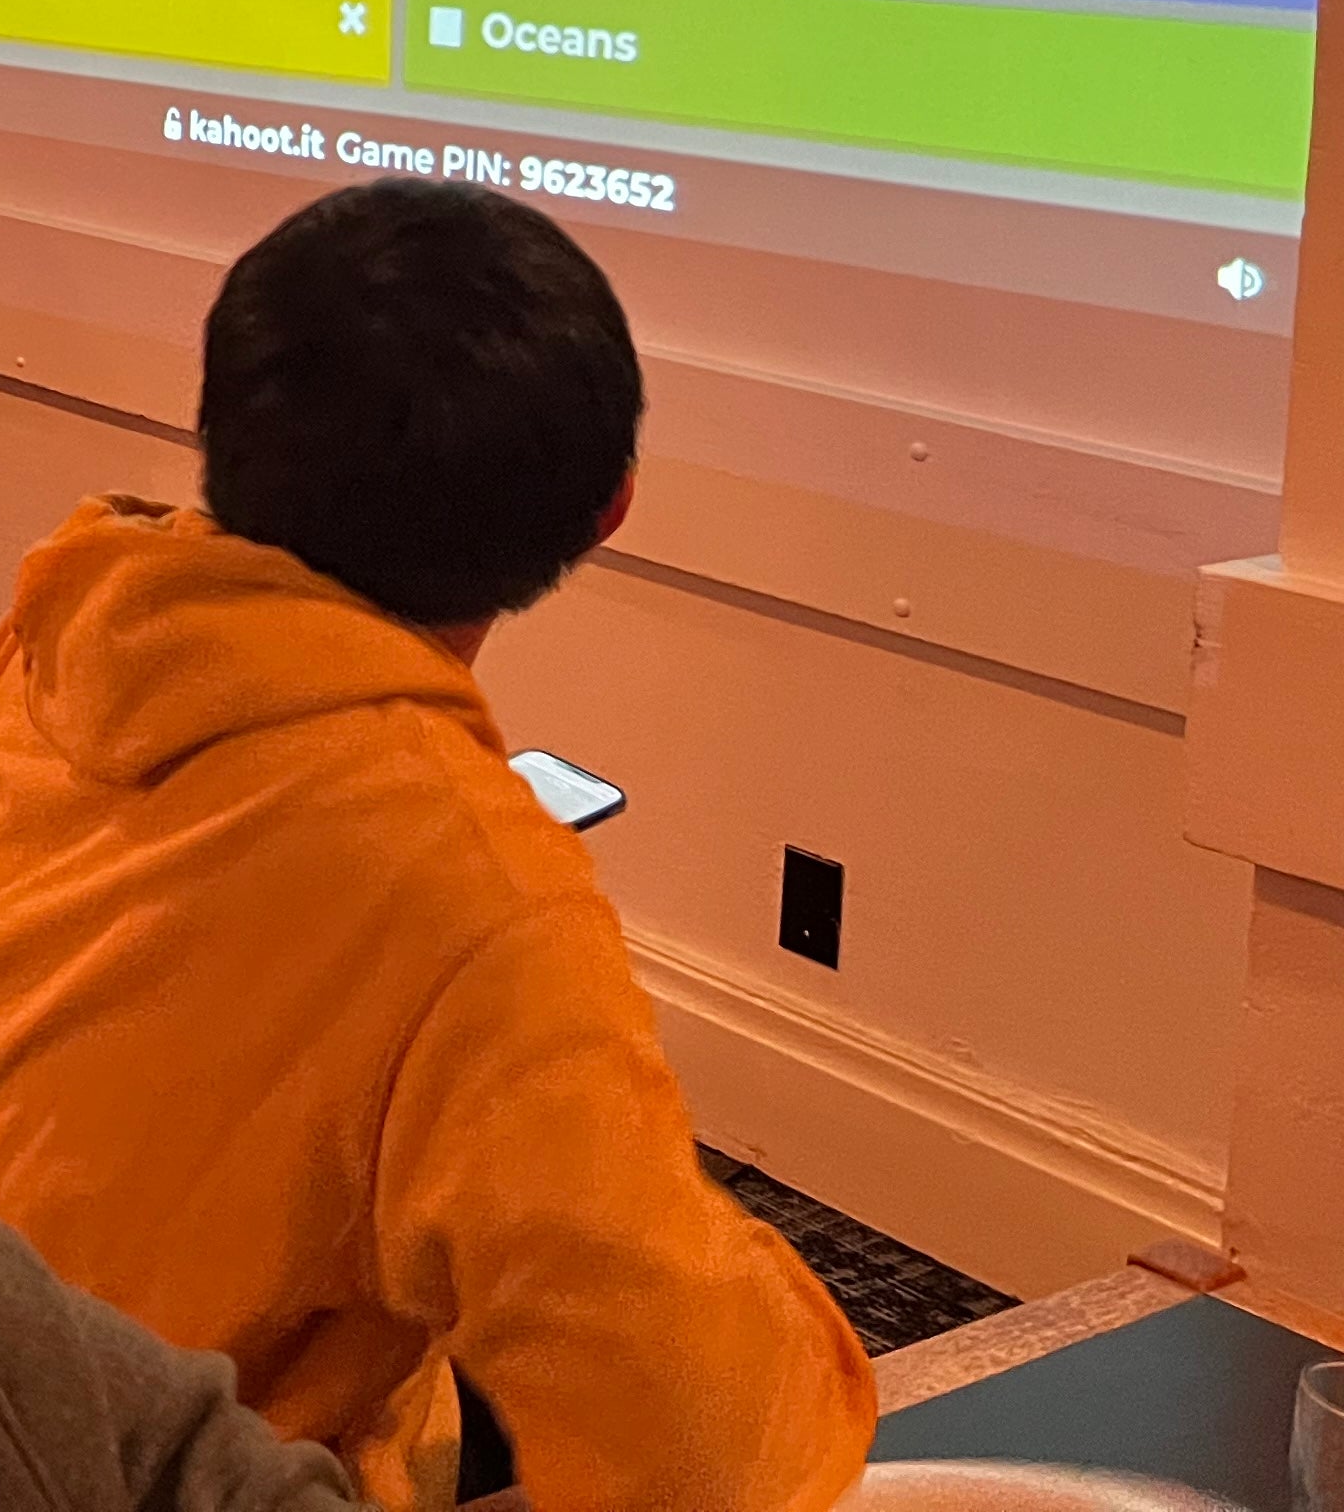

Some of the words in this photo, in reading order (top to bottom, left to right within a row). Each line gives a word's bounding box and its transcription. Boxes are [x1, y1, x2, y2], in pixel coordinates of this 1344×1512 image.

[480, 13, 638, 62] Oceans
[189, 109, 326, 160] kahoot.it
[336, 131, 434, 175] Game
[442, 145, 511, 186] PIN:
[519, 156, 676, 213] 9623652
